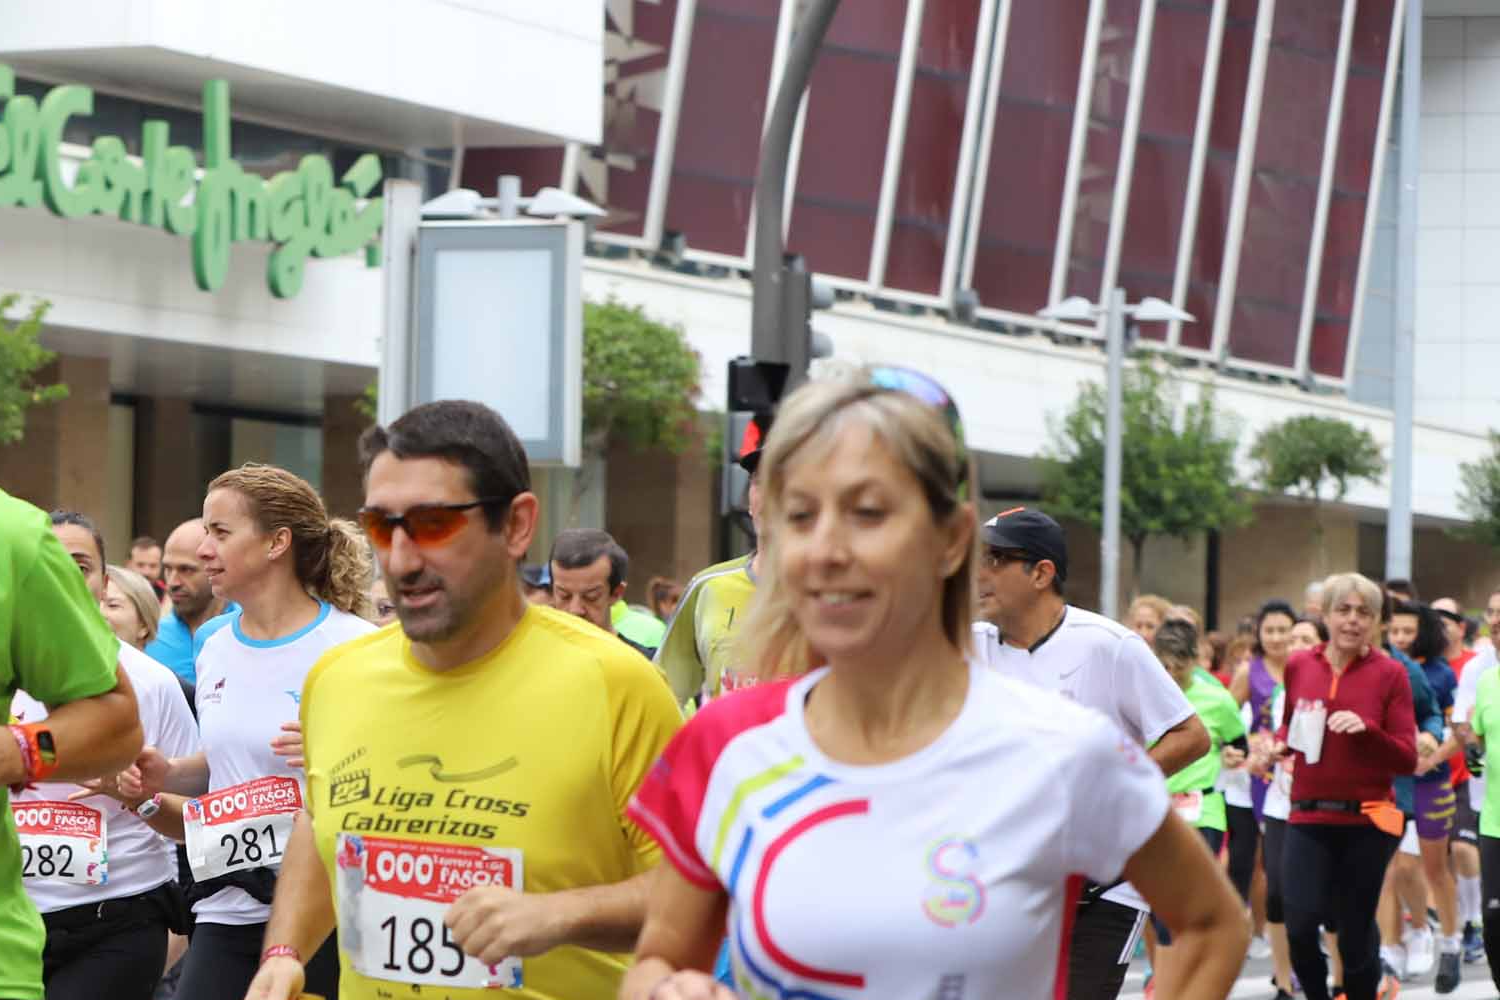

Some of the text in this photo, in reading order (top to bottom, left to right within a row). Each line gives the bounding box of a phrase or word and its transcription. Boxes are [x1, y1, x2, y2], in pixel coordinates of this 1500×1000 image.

[40, 84, 197, 237] Corte
[199, 791, 248, 825] 1.000
[251, 787, 297, 806] PASOS
[372, 785, 531, 818] Liga Cross
[14, 807, 52, 827] 000
[54, 815, 97, 826] PASOS
[341, 811, 498, 840] Cabrerizos
[21, 844, 75, 878] 282
[220, 823, 283, 868] 281
[362, 849, 434, 886] 1.000
[380, 915, 466, 977] 185
